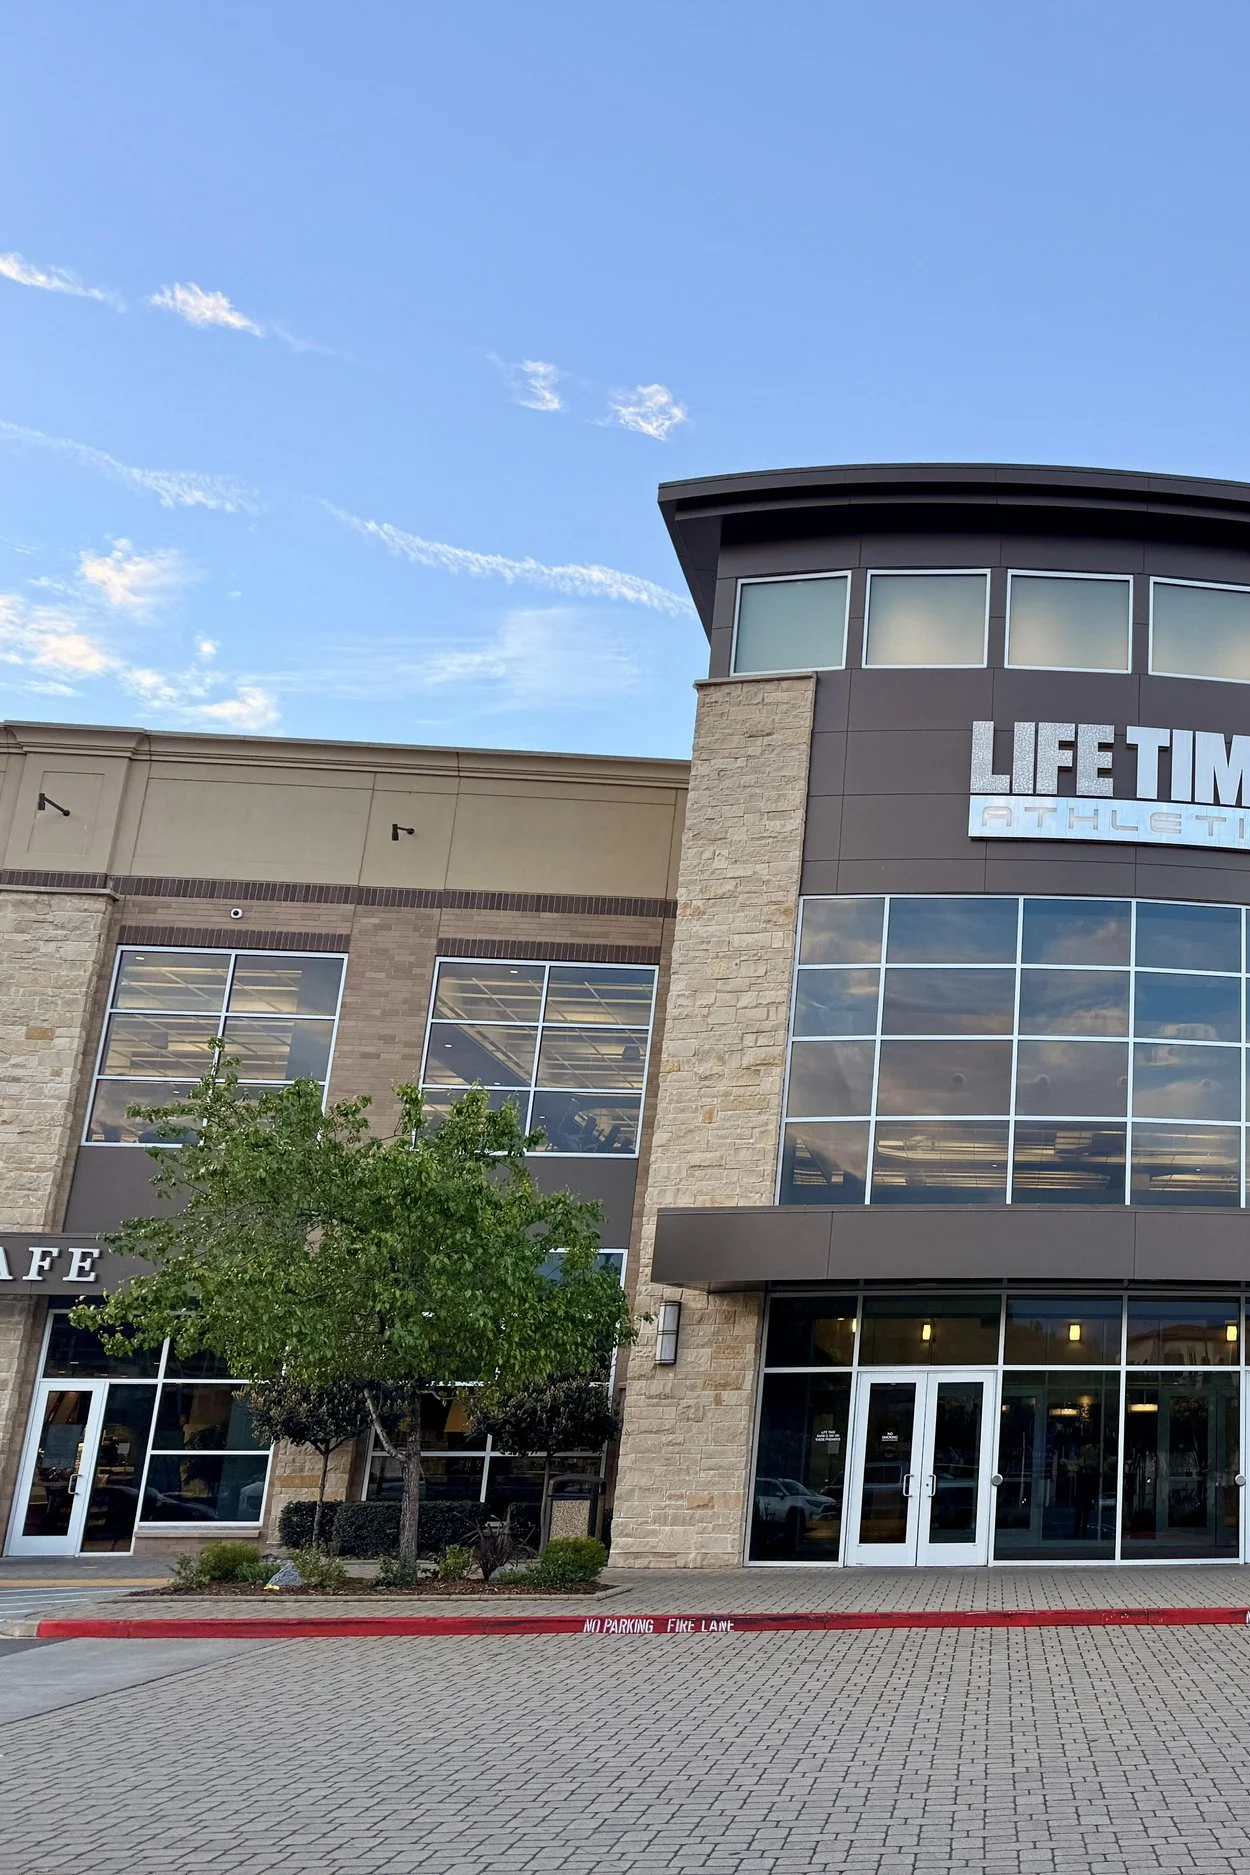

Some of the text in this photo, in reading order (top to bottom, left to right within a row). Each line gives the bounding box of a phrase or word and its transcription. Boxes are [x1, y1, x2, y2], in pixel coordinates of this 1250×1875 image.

[970, 721, 1115, 797] LIFE
[583, 1618, 735, 1634] NO PARKING FIRE LANE
